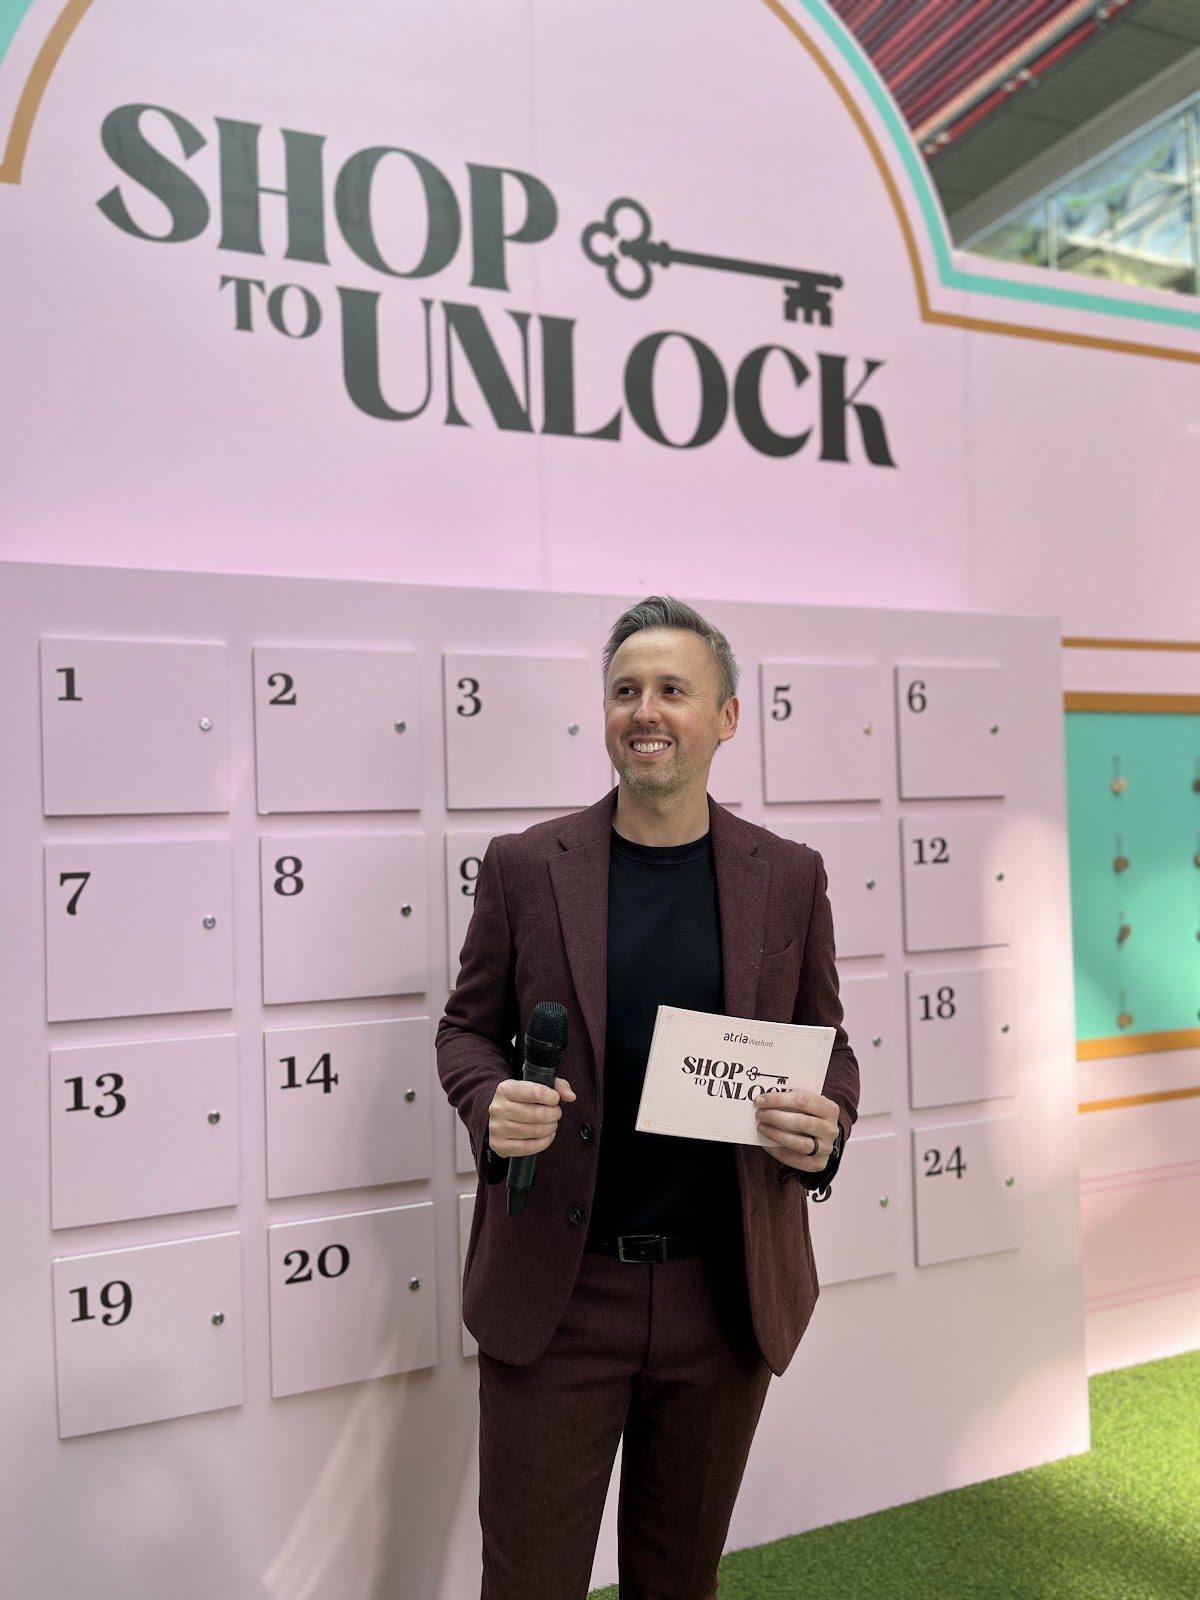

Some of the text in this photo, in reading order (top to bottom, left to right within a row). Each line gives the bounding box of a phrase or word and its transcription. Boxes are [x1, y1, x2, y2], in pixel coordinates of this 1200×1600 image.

[95, 102, 559, 292] SHOP
[220, 275, 898, 469] TO UNLOCK
[55, 666, 83, 702] 1
[267, 672, 297, 706] 2
[456, 677, 483, 718] 3
[771, 684, 793, 722] 5
[906, 679, 928, 714] 6
[912, 836, 950, 866] 12
[59, 871, 92, 916] 7
[273, 855, 305, 897] 8
[918, 985, 957, 1022] 18
[723, 1032, 774, 1048] atria Watford
[279, 1052, 339, 1095] 14
[681, 1055, 744, 1080] SHOP
[64, 1072, 127, 1119] 13
[694, 1077, 794, 1102] TO UNLO
[923, 1145, 967, 1180] 24
[283, 1243, 351, 1285] 20
[69, 1280, 133, 1327] 19
